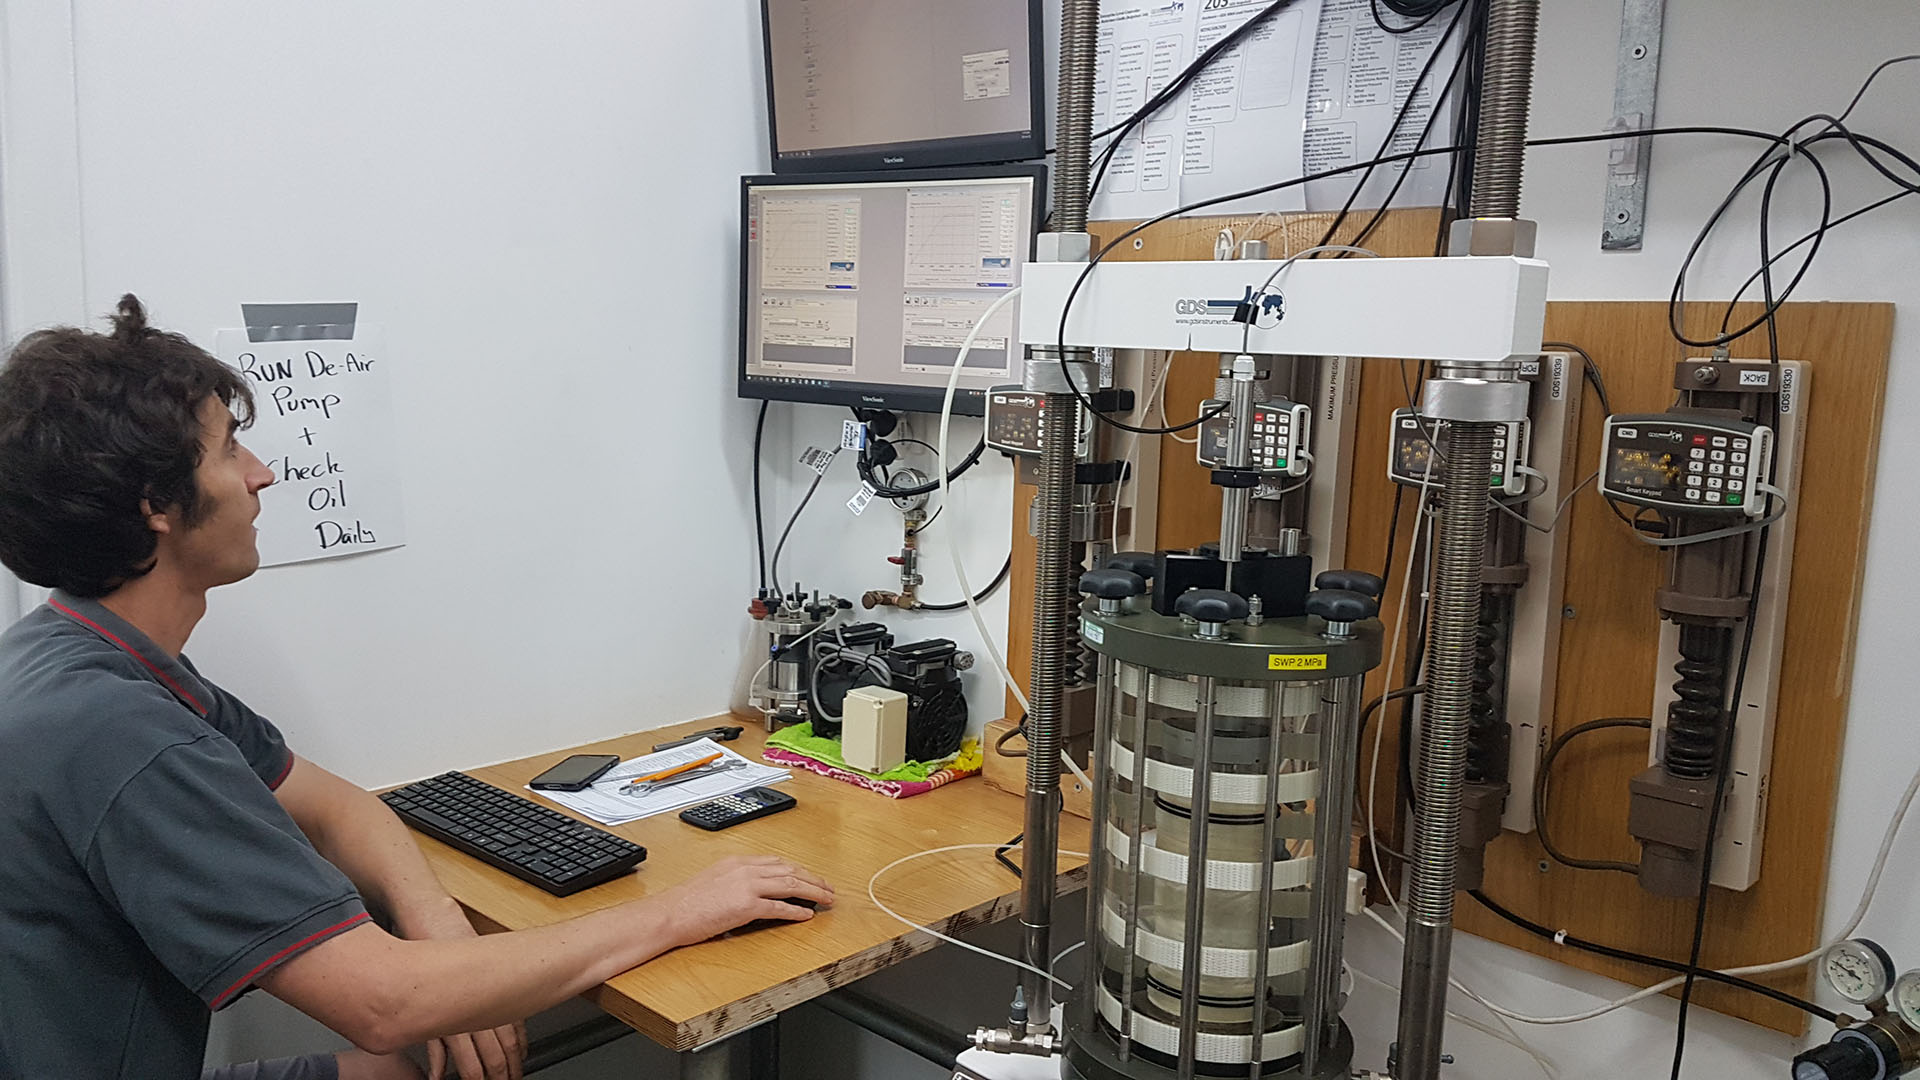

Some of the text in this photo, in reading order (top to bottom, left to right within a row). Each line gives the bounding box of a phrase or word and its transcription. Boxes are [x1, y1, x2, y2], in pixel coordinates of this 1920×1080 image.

[1175, 299, 1207, 315] GDS
[238, 351, 375, 382] RUN De-Air
[1743, 374, 1767, 383] BACK
[271, 386, 341, 418] Pump
[1328, 386, 1336, 420] MAXIMUM
[1781, 369, 1793, 412] GDS19330
[298, 427, 317, 445] +
[308, 480, 346, 510] Oil
[1642, 489, 1662, 497] Keypad
[314, 521, 376, 549] Daily
[1273, 658, 1323, 667] SWP 2 MPa
